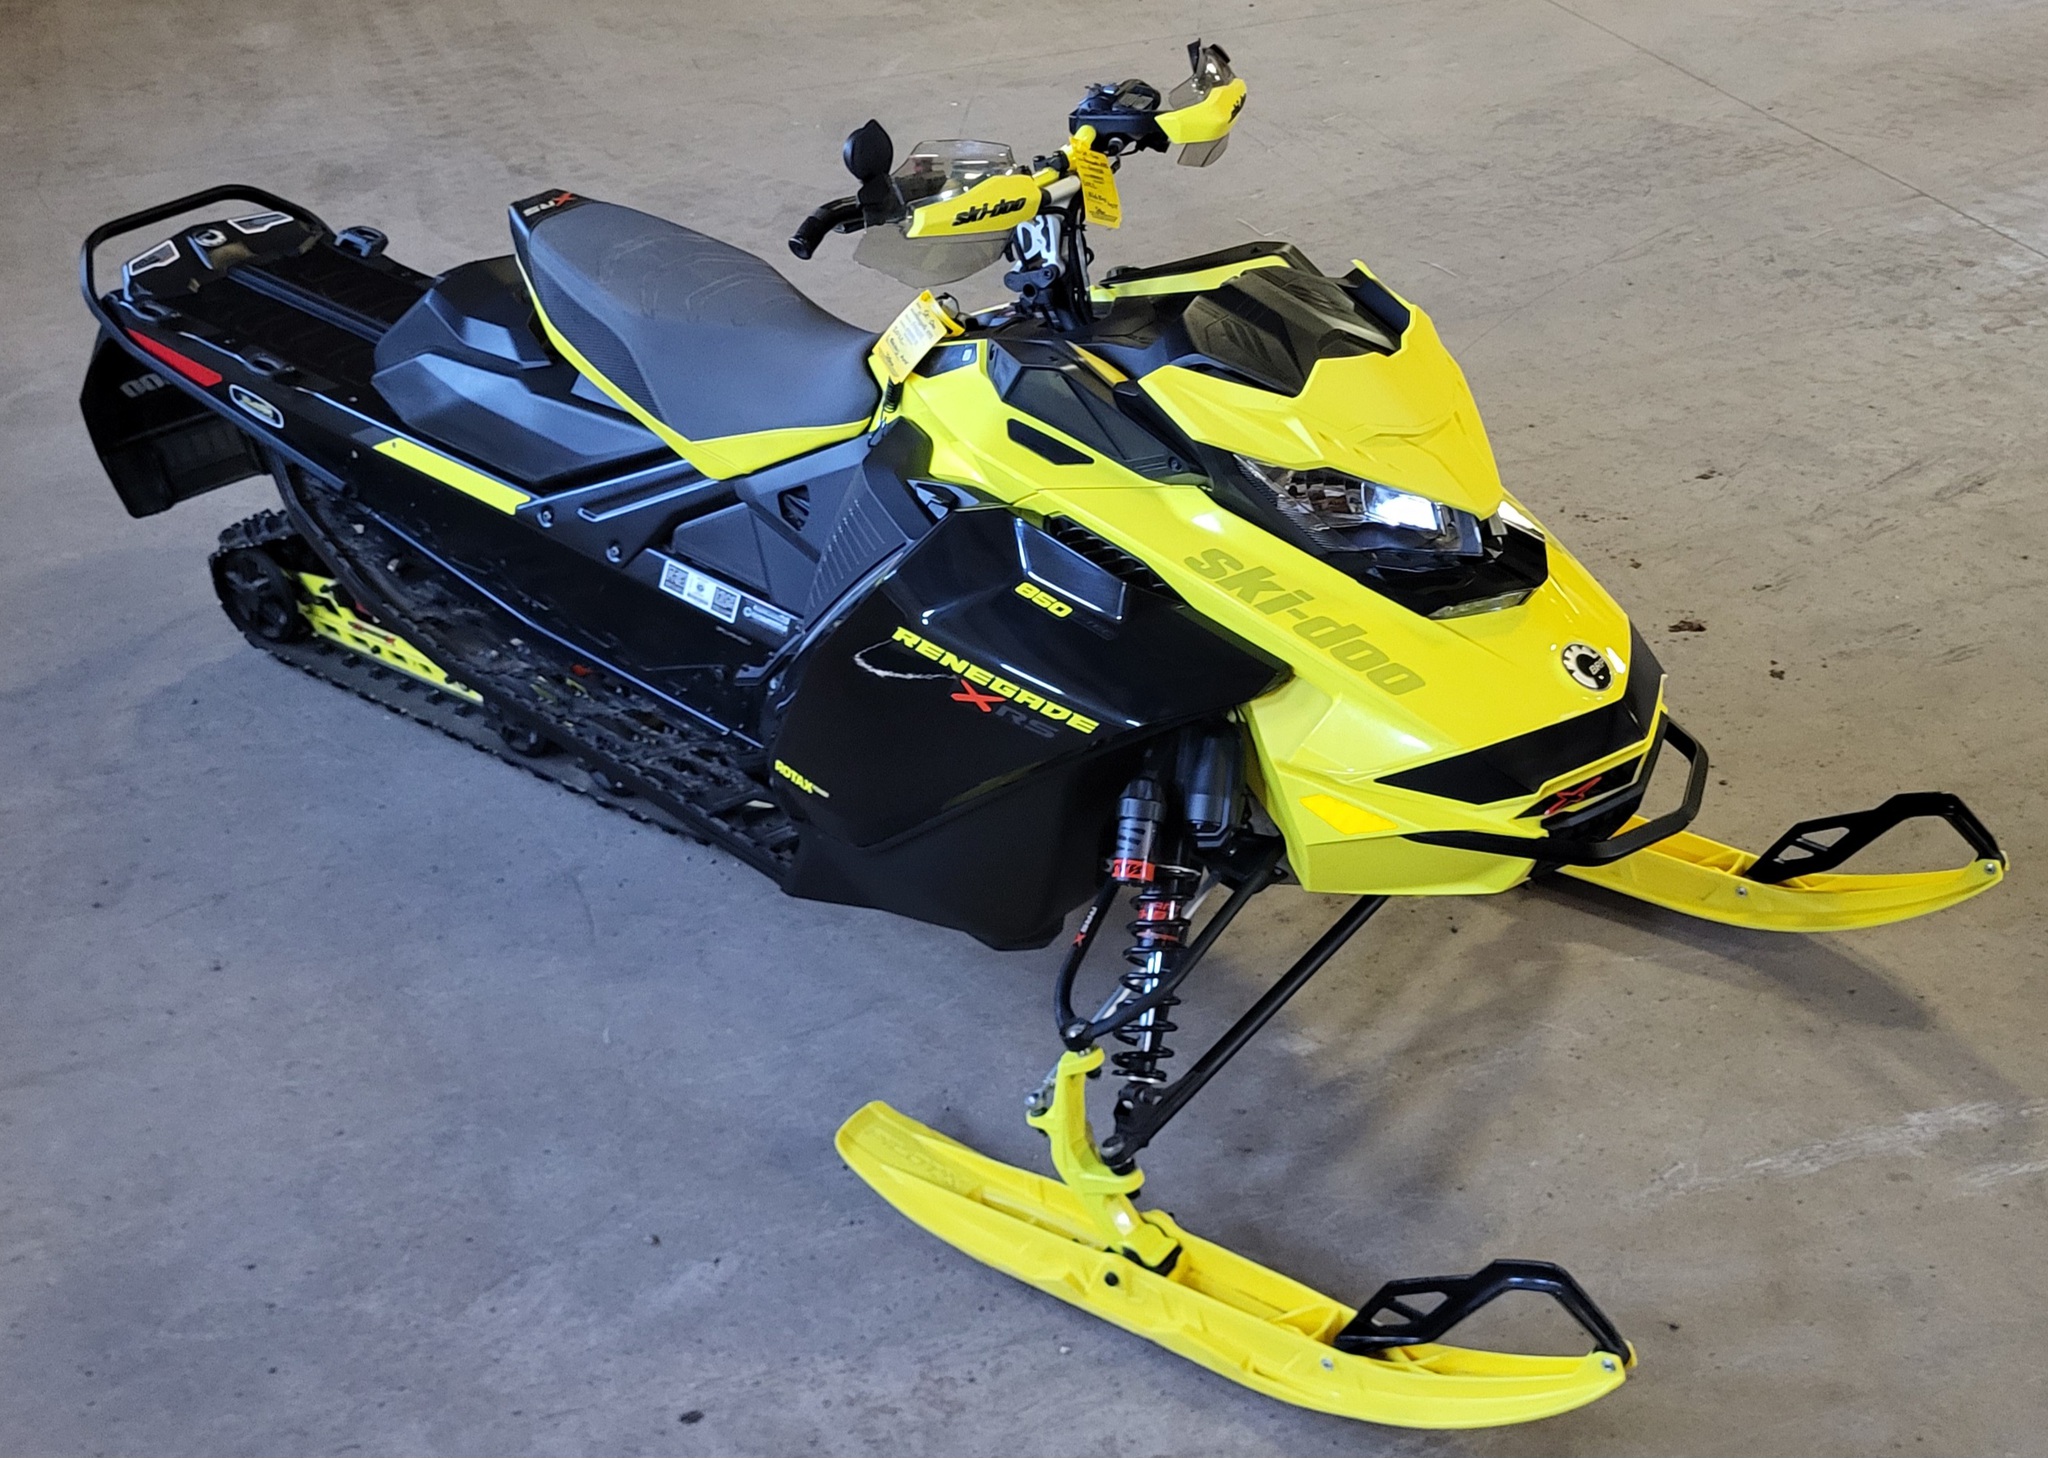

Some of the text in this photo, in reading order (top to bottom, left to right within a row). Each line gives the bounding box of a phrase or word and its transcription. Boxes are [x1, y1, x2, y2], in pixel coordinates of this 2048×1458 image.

[952, 197, 1026, 227] ski-doo
[1014, 581, 1074, 618] 850
[1183, 548, 1427, 696] ski-doo
[891, 626, 1100, 735] RENEGADE
